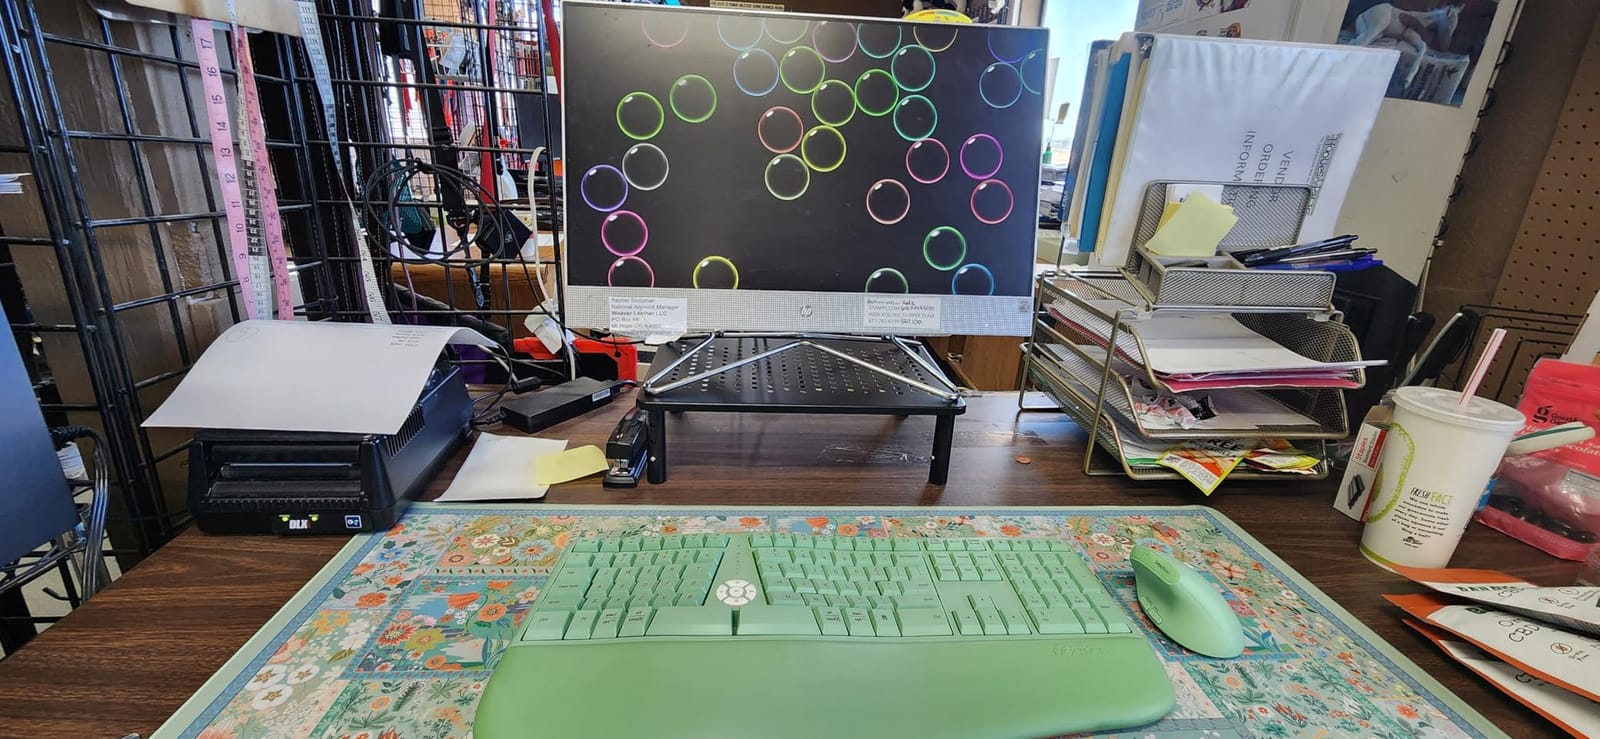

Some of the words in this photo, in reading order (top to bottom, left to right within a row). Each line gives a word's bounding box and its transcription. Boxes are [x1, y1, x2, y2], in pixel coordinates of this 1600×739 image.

[200, 38, 212, 49] 17
[206, 66, 217, 77] 16
[211, 94, 223, 105] 15
[216, 121, 227, 131] 14
[220, 147, 232, 158] 13
[225, 173, 236, 183] 12
[231, 200, 240, 208] 11
[235, 223, 244, 233] 10
[800, 305, 813, 318] hp
[1409, 487, 1431, 499] FRESH
[1430, 491, 1454, 505] FACT
[1508, 624, 1541, 643] CBD
